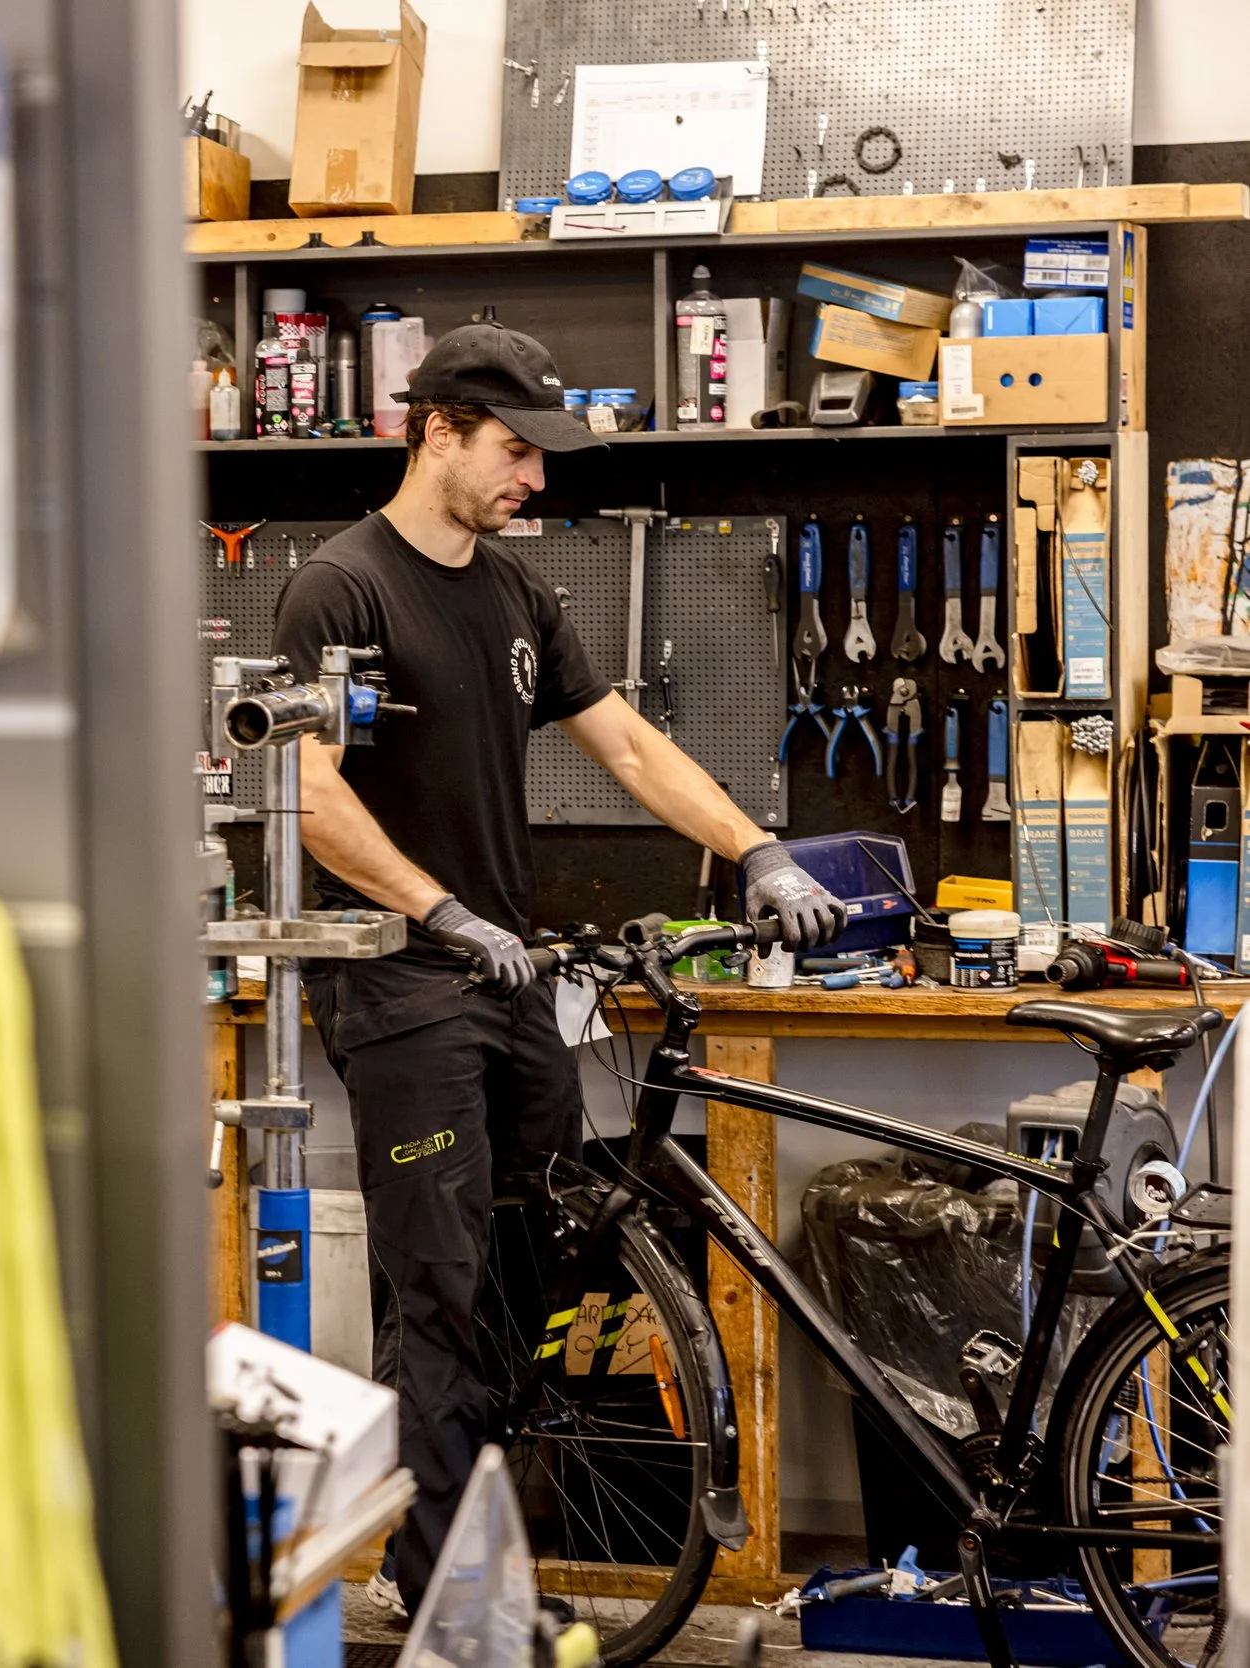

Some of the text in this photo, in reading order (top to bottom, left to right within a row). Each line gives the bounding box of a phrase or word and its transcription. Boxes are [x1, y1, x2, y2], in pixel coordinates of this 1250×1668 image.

[510, 658, 524, 693] BRNO
[198, 754, 229, 771] ROK
[1020, 829, 1057, 839] BRAKE
[1069, 828, 1105, 838] BRAKE
[700, 1197, 772, 1267] FUJI
